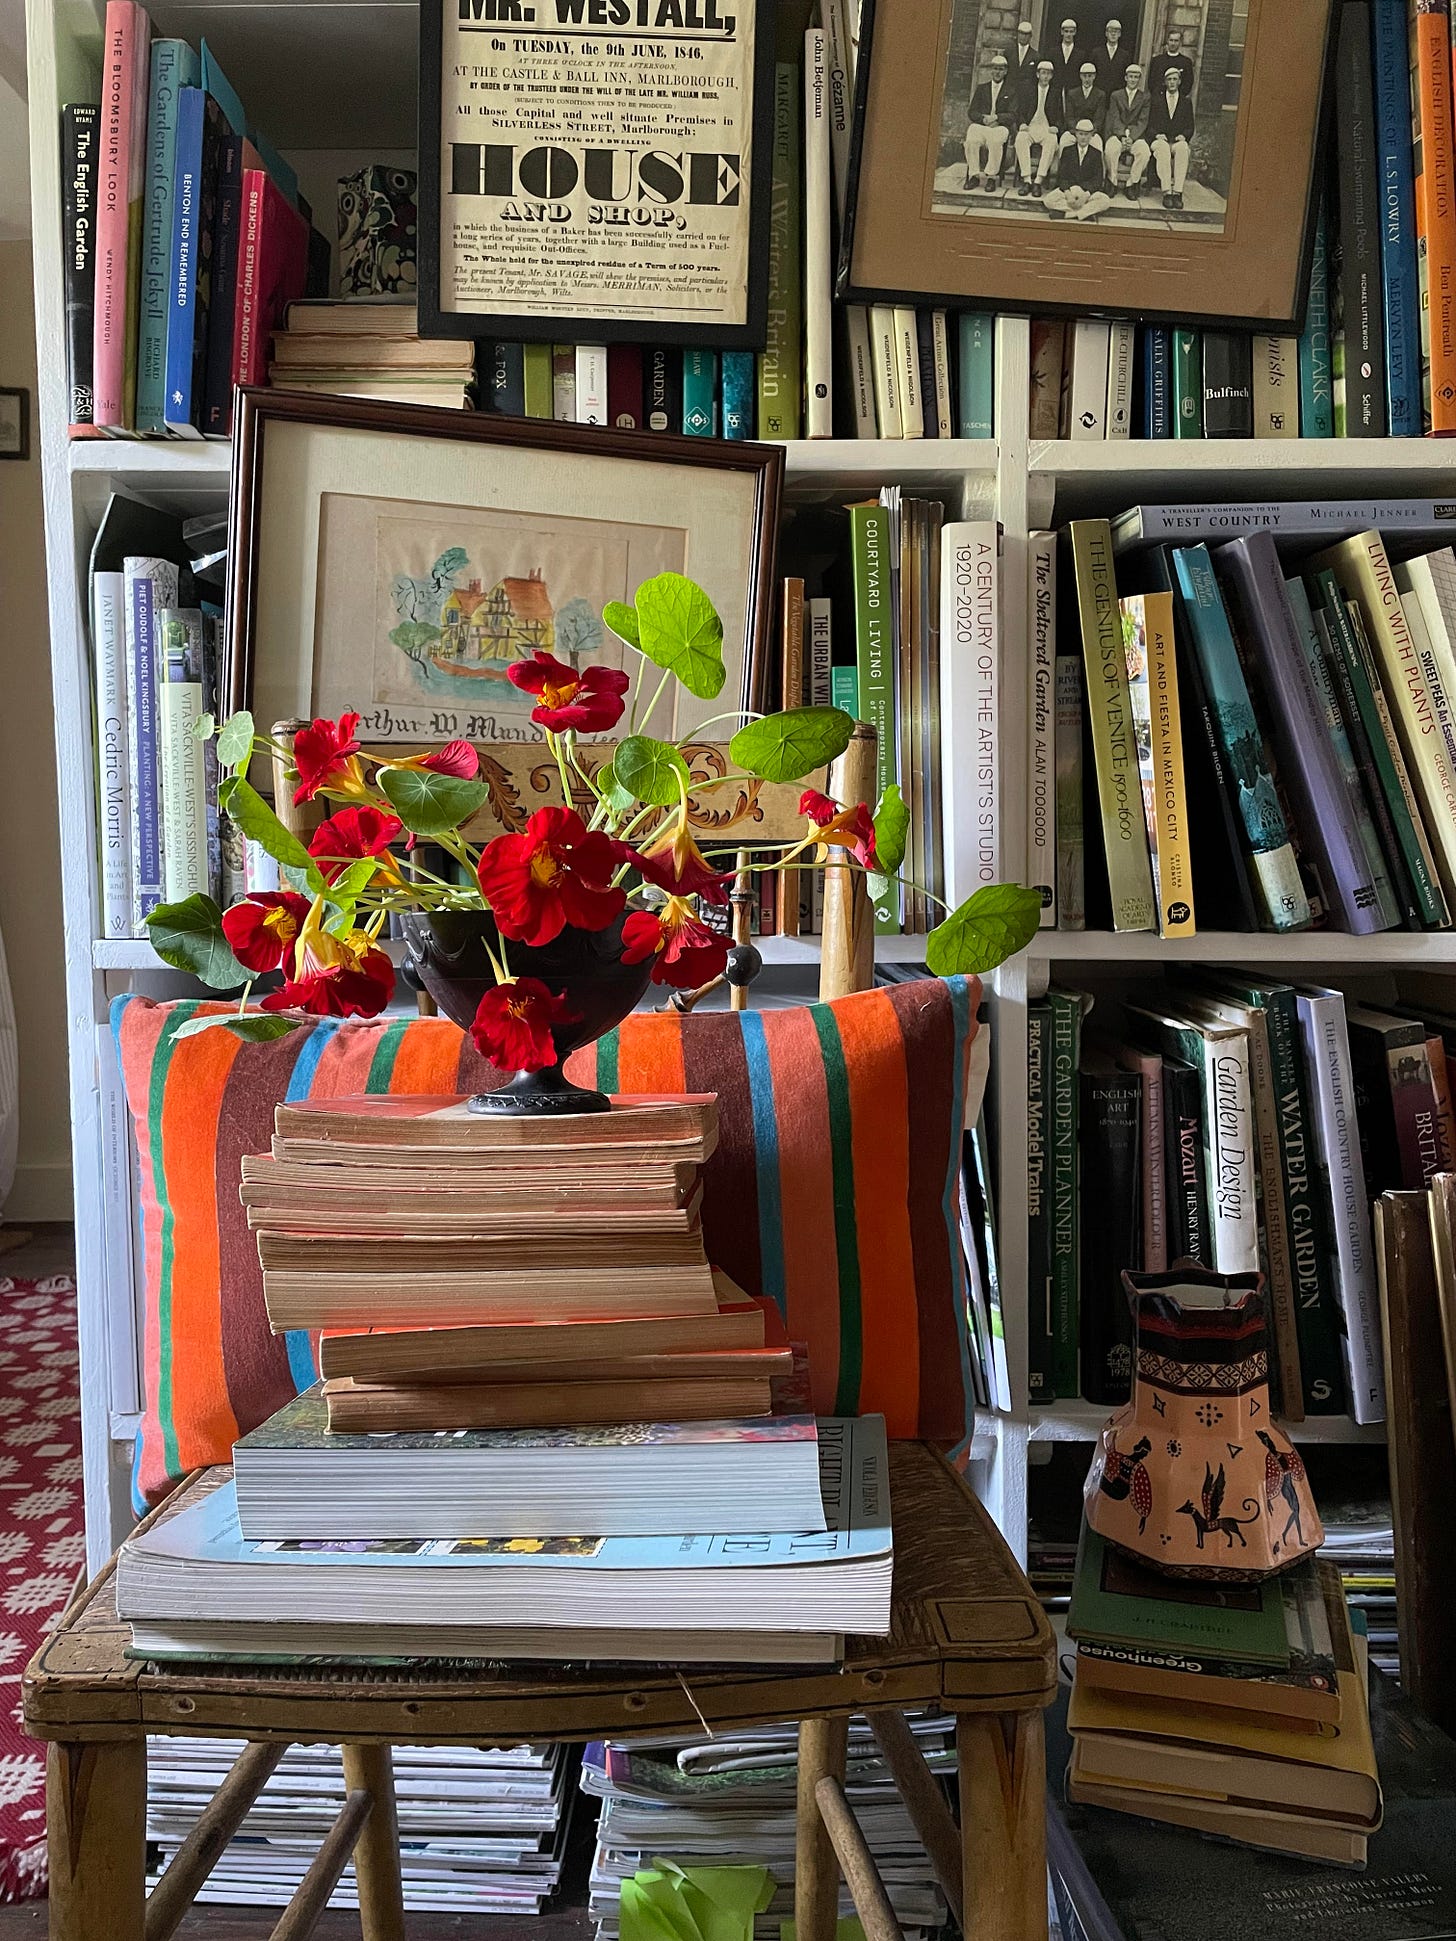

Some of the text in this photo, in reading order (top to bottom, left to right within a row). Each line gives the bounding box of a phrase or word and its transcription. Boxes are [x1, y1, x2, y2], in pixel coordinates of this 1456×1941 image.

[458, 0, 736, 36] MR. WESTALL,
[452, 65, 738, 91] AT THE CASTLE & BALL INN, MARLBOROUGH,
[491, 37, 506, 52] On
[513, 39, 574, 56] TUESDAY,
[581, 44, 599, 56] the
[606, 43, 625, 57] 9th
[631, 44, 667, 60] JUNE,
[812, 35, 824, 119] John Betjeman
[106, 29, 123, 212] THE BLOOMSBURY LOOK
[455, 105, 734, 126] All those Capital and well situate Premises in
[491, 118, 696, 137] SILVERLESS STREET, Marlborough;
[831, 69, 846, 132] Cézanne
[1429, 36, 1448, 218] ENGLISH DECORATION
[73, 131, 90, 271] The English Garden
[144, 49, 174, 319] The Gardens of Gertrude Jekyll
[447, 142, 741, 206] HOUSE
[178, 173, 193, 307] BENTON END REMEMBERED
[499, 201, 687, 231] AND SHOP,
[240, 191, 258, 365] LONDON OF CHARLES DICKENS
[104, 284, 112, 345] HITCHMOUGH
[1310, 231, 1329, 405] KENNETH CLARK
[1361, 305, 1369, 350] LITTLEWOOD
[1389, 278, 1403, 382] MERVYN LEVY
[1440, 265, 1453, 358] Ben Pentreath
[652, 351, 664, 407] GARDEN
[762, 308, 788, 398] Britain
[937, 363, 945, 400] Collection
[1154, 329, 1163, 434] SALLY GRIFFITHS
[1205, 387, 1249, 400] Bulfinch
[1362, 393, 1372, 426] Schiffer
[1162, 514, 1281, 528] WEST COUNTRY
[138, 584, 147, 602] PIET
[865, 519, 882, 679] COURTYARD LIVING
[956, 543, 973, 643] 1920-2020
[139, 603, 148, 646] OUDOLF
[814, 615, 829, 637] THE
[1368, 543, 1436, 735] LIVING WITH PLANTS
[140, 653, 149, 680] NOEL
[814, 640, 829, 682] URBAN
[1089, 535, 1135, 841] THE GENIUS OF VENICE 1500-1600
[1420, 650, 1439, 683] SWEET
[102, 594, 125, 849] JANET WAYMARK Cedric Morris
[141, 682, 150, 734] KINGSBURY
[181, 692, 192, 718] VITA
[344, 704, 428, 734] rthur.
[976, 542, 994, 881] A CENTURY OF THE ARTIST'S STUDIO
[1034, 552, 1051, 848] The Sheltered Garden ALAN TOOGOOD
[1430, 683, 1446, 709] PEAS
[1437, 709, 1448, 723] An
[1154, 632, 1178, 842] ART AND FIESTA IN MEXICO CITY
[1202, 705, 1216, 748] TARQUIN
[143, 741, 152, 788] PLANTING:
[1433, 753, 1451, 791] GEORGE
[145, 791, 153, 799] A
[145, 800, 153, 820] NEW
[146, 821, 154, 880] PERSPECTIVE
[1028, 1019, 1044, 1216] PRACTICAL Model Trains
[1055, 1004, 1072, 1257] THE GARDEN PLANNER
[1216, 1056, 1247, 1220] Garden Design
[1324, 1018, 1363, 1274] THE ENGLISH COUNTRY HOUSE GARDEN
[1179, 1116, 1199, 1231] Mozart HENRY
[1280, 1089, 1321, 1310] WATER GARDEN
[1080, 1644, 1203, 1674] Greenhouse
